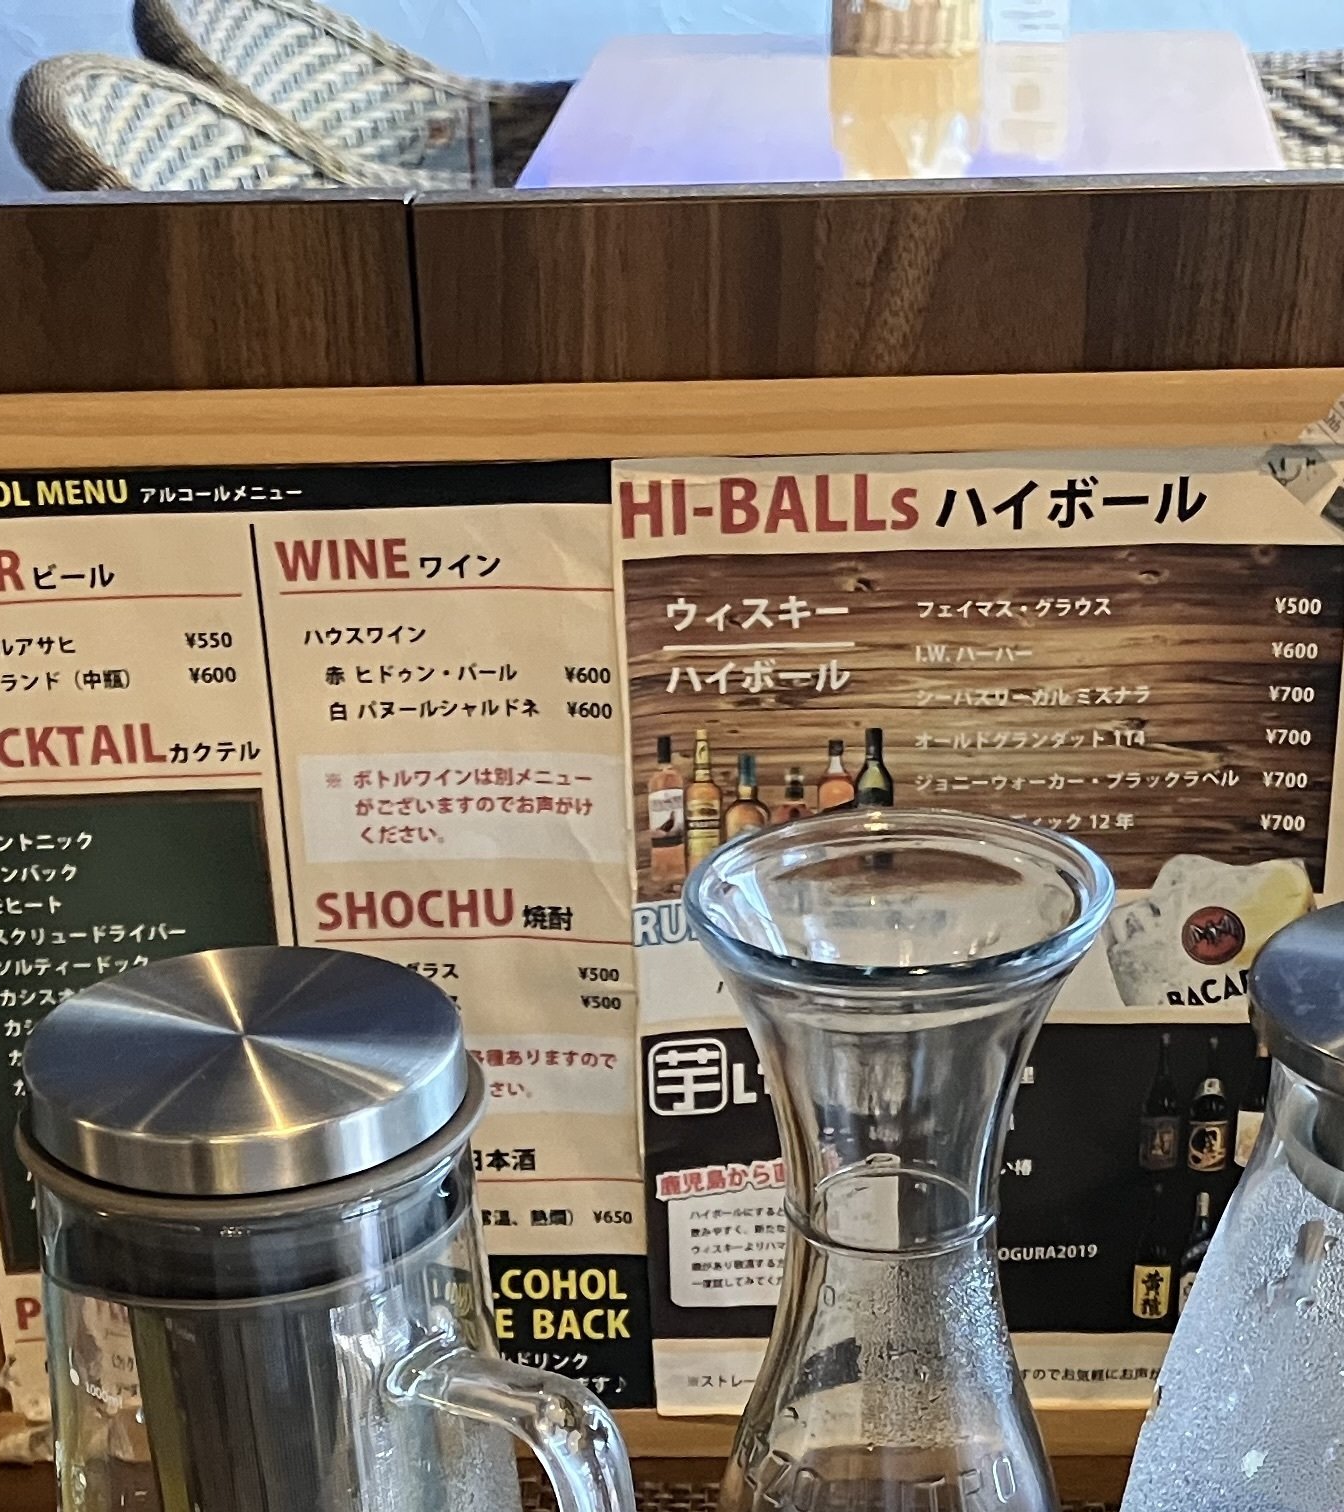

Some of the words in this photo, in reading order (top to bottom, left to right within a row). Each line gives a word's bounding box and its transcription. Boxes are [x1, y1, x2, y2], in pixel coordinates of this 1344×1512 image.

[36, 477, 130, 508] MENU
[140, 484, 304, 504] アルコールメニュー
[618, 473, 921, 541] HI-BALLs
[935, 476, 1207, 532] ハイボール
[274, 538, 411, 583] WINE
[419, 554, 502, 580] ワイン
[32, 562, 116, 590] ビール
[665, 595, 850, 632] ウィスキー
[916, 598, 1113, 619] フェイマス・グラウス
[1275, 597, 1323, 616] ¥500
[185, 631, 234, 650] ¥550
[304, 626, 427, 646] ハウスワイン
[1271, 641, 1319, 660] ¥600
[188, 665, 237, 685] ¥600
[324, 666, 346, 686] 赤
[564, 666, 612, 685] ¥600
[665, 659, 852, 694] ハイボール
[1268, 685, 1316, 704] ¥700
[330, 701, 348, 721] 白
[567, 700, 613, 720] ¥600
[1265, 728, 1312, 747] ¥700
[168, 740, 262, 765] カクテル
[353, 767, 594, 788] ボトルワインは別メニュー
[913, 770, 1241, 793] ジョニーウォーカー・ブラックラベル
[1262, 771, 1309, 790] ¥700
[355, 795, 594, 818] がございますのでお声がけ
[1089, 814, 1111, 831] 12
[1115, 813, 1136, 831] 年
[1260, 814, 1307, 833] ¥700
[359, 826, 446, 846] ください。
[315, 888, 516, 932] SHOCHU
[522, 904, 575, 932] 焼酎
[632, 903, 701, 948] RU
[578, 966, 621, 983] ¥500
[581, 995, 623, 1011] ¥500
[592, 1210, 634, 1225] ¥650
[493, 1268, 628, 1301] COHOL
[532, 1308, 632, 1341] BACK
